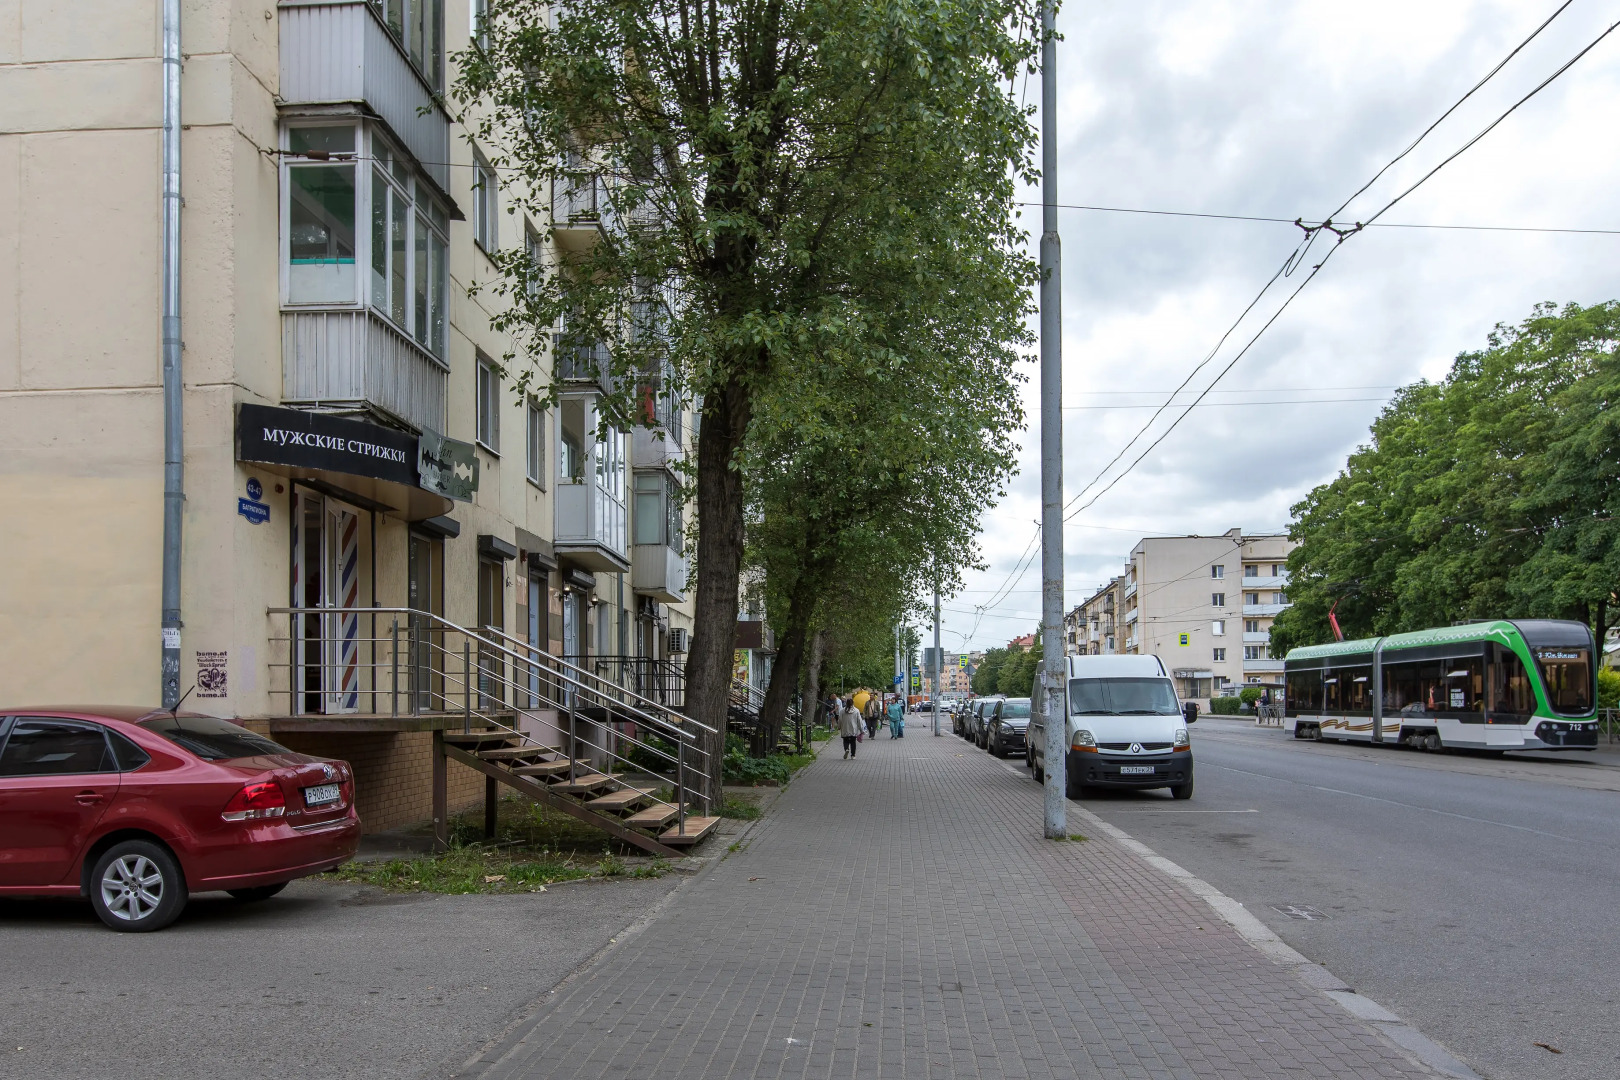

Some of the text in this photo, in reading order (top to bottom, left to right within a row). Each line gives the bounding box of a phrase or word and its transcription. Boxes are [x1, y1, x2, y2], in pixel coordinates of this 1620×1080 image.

[263, 427, 406, 464] МУЖСКИЕ СТРИЖКИ
[247, 483, 262, 496] 43-47
[242, 503, 267, 516] БАГРАТИОНА
[1569, 723, 1582, 731] 712
